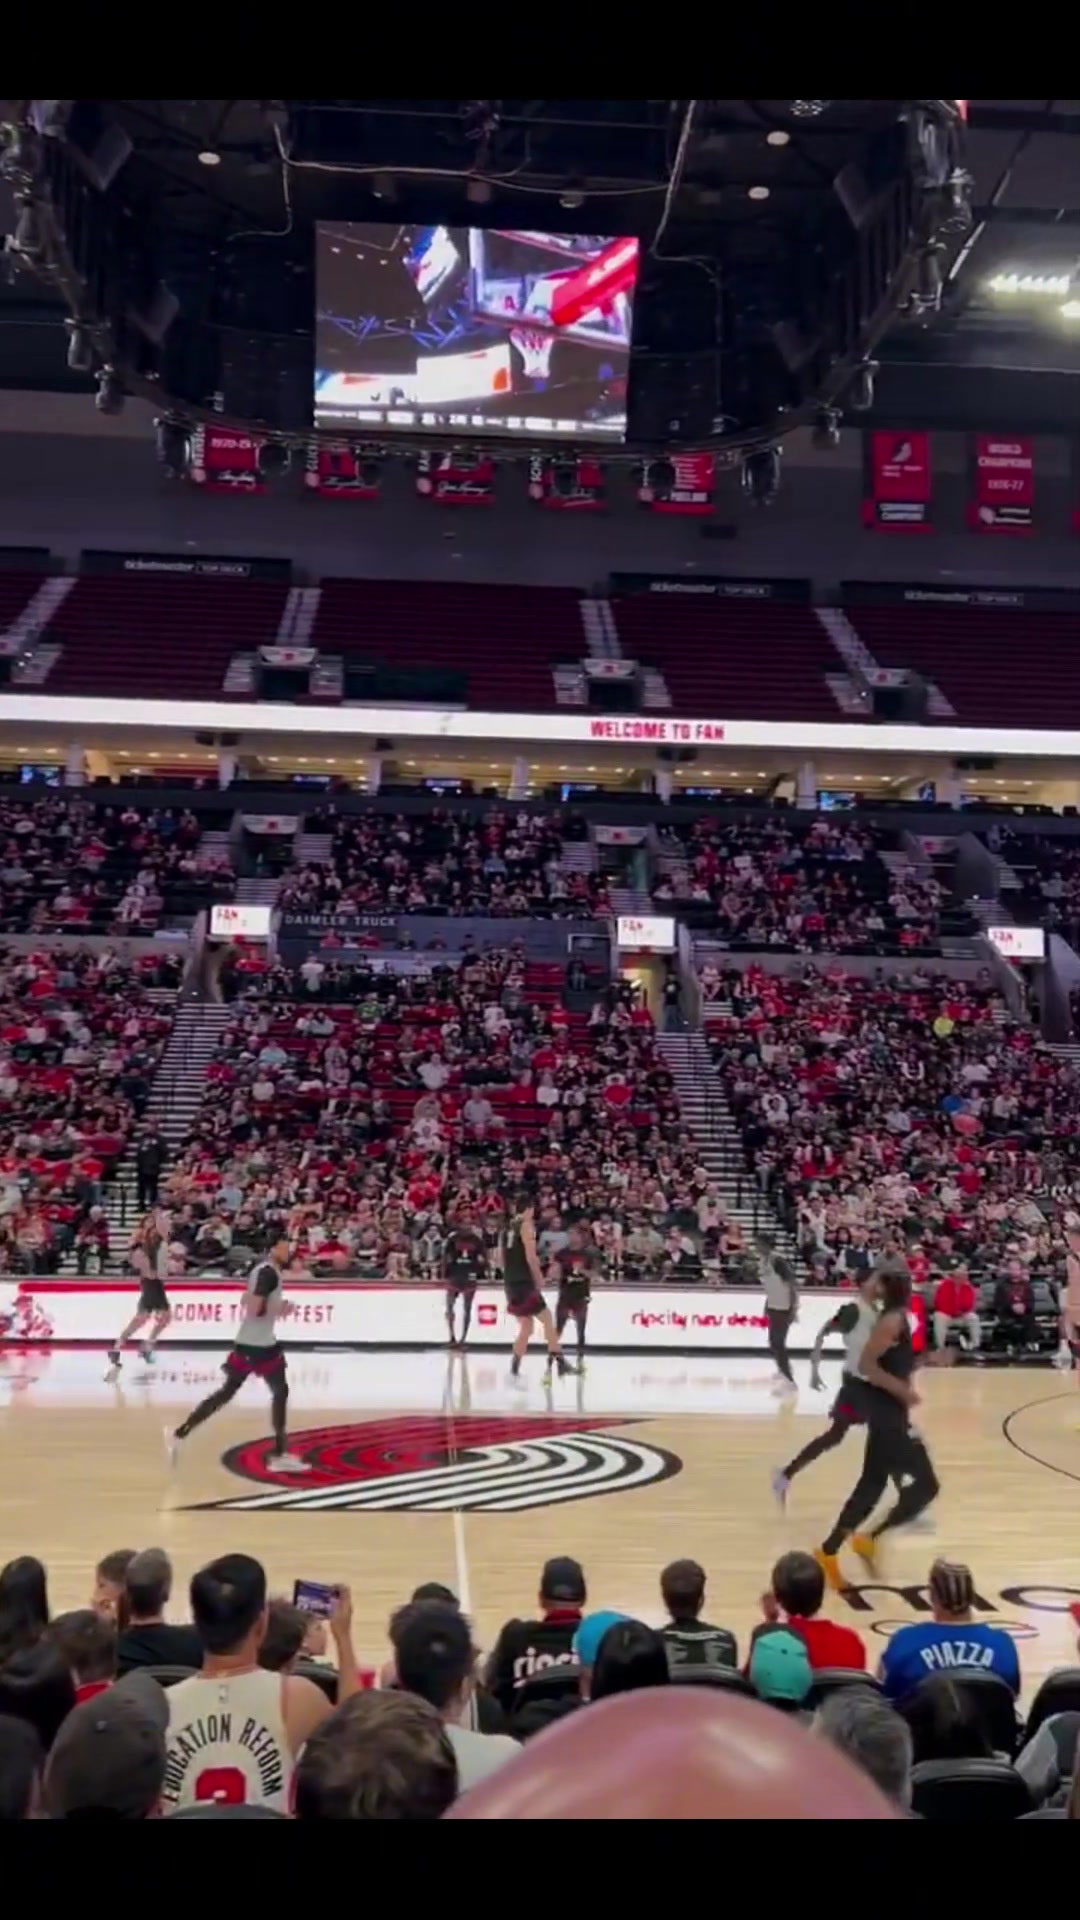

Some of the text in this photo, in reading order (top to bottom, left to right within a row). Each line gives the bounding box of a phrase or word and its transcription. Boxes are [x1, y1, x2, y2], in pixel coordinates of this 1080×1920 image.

[977, 456, 1033, 469] CHAMPIONS
[590, 720, 725, 740] WELCOME TO FAN
[285, 914, 396, 927] DAIMLER TRUCK
[174, 1303, 223, 1322] COME
[292, 1304, 334, 1323] FEST
[919, 1640, 995, 1671] PIAZZA
[162, 1712, 232, 1804] EDUCATION
[237, 1716, 284, 1798] REFORM
